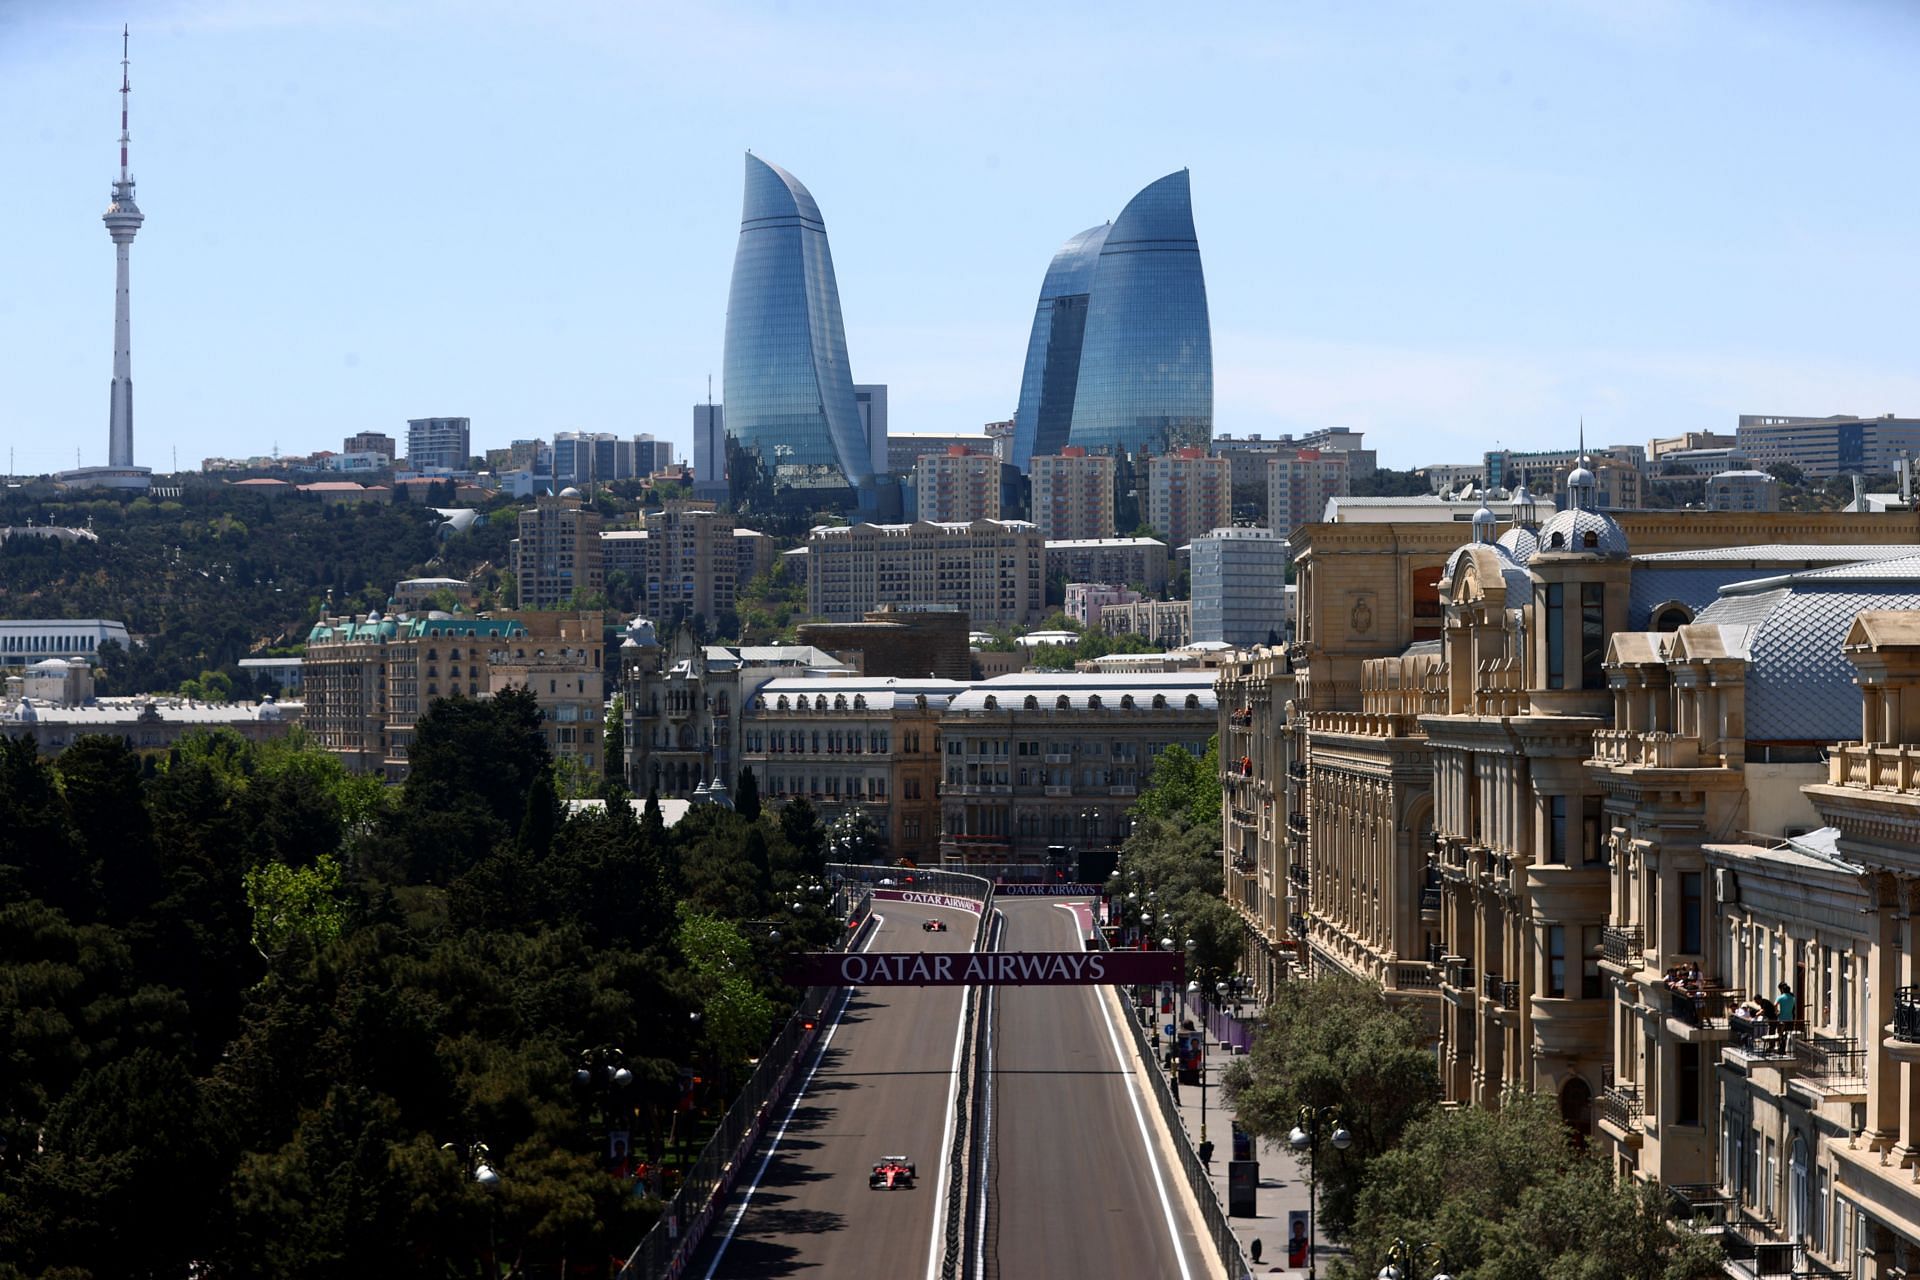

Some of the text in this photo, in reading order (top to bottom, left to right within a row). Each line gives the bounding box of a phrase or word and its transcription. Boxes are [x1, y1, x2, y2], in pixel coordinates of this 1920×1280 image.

[1006, 885, 1096, 895] QATAR AIRWAYS
[902, 893, 975, 911] QATAR AIRWAYS
[840, 956, 1105, 983] QATAR AIRWAYS
